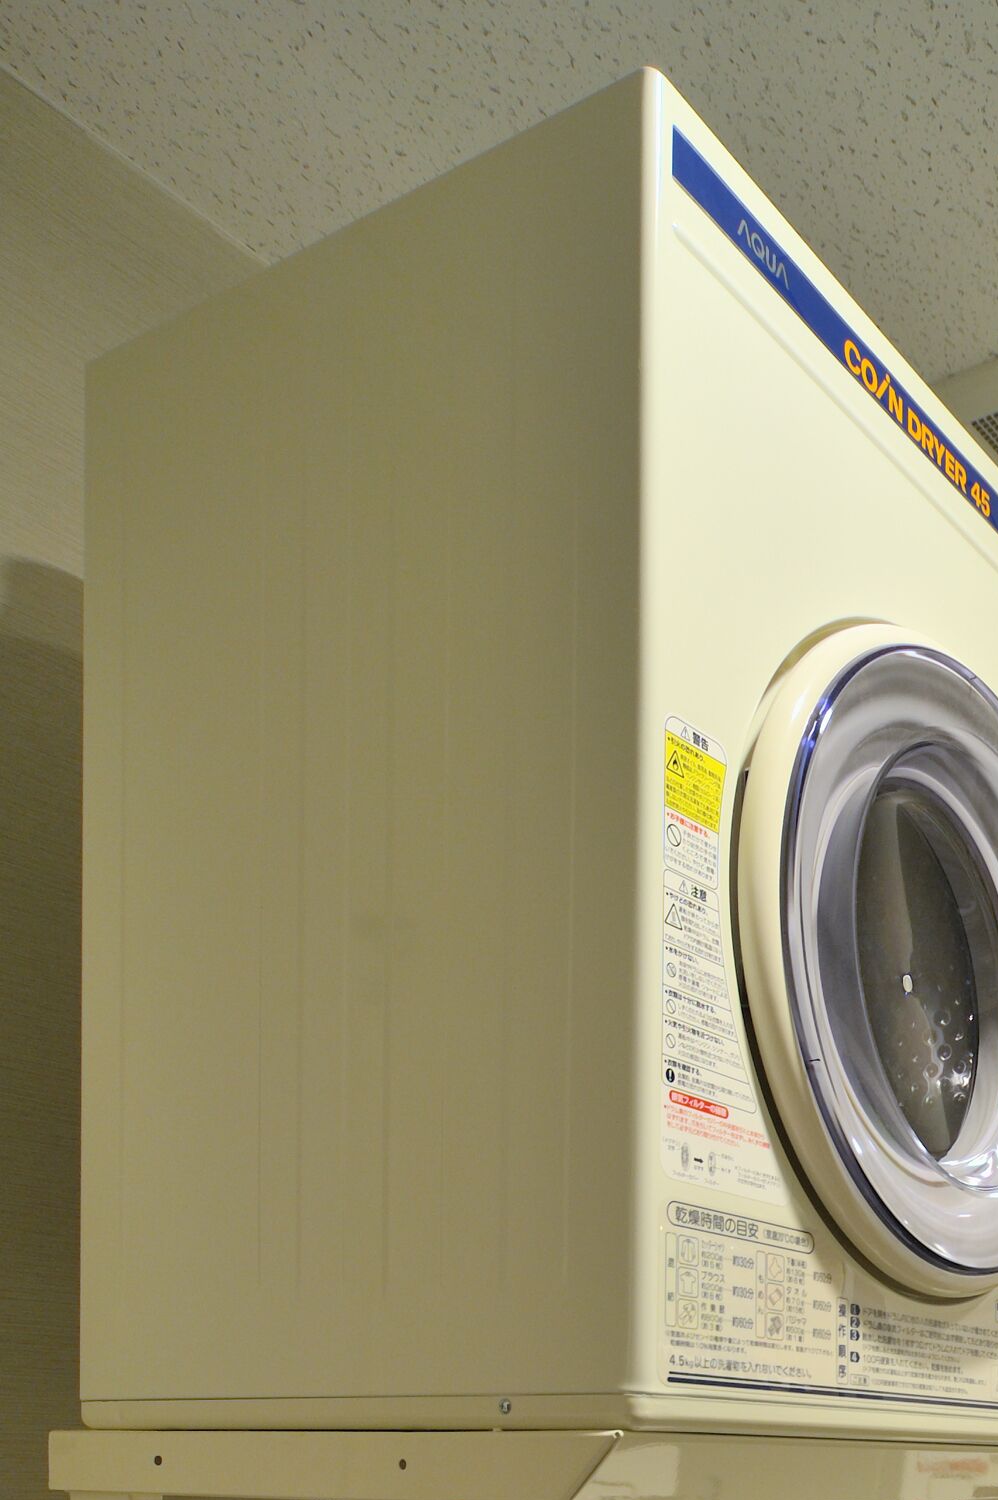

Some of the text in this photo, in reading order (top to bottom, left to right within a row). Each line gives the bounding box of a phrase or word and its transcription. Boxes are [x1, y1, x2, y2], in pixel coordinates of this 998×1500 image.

[737, 219, 789, 290] AQUA
[907, 408, 967, 494] DRYER
[970, 481, 991, 518] 45
[693, 731, 708, 751] 警告
[691, 884, 707, 902] 注意
[676, 1206, 759, 1239] 乾燥時間の目安
[701, 1271, 725, 1283] ブラウス
